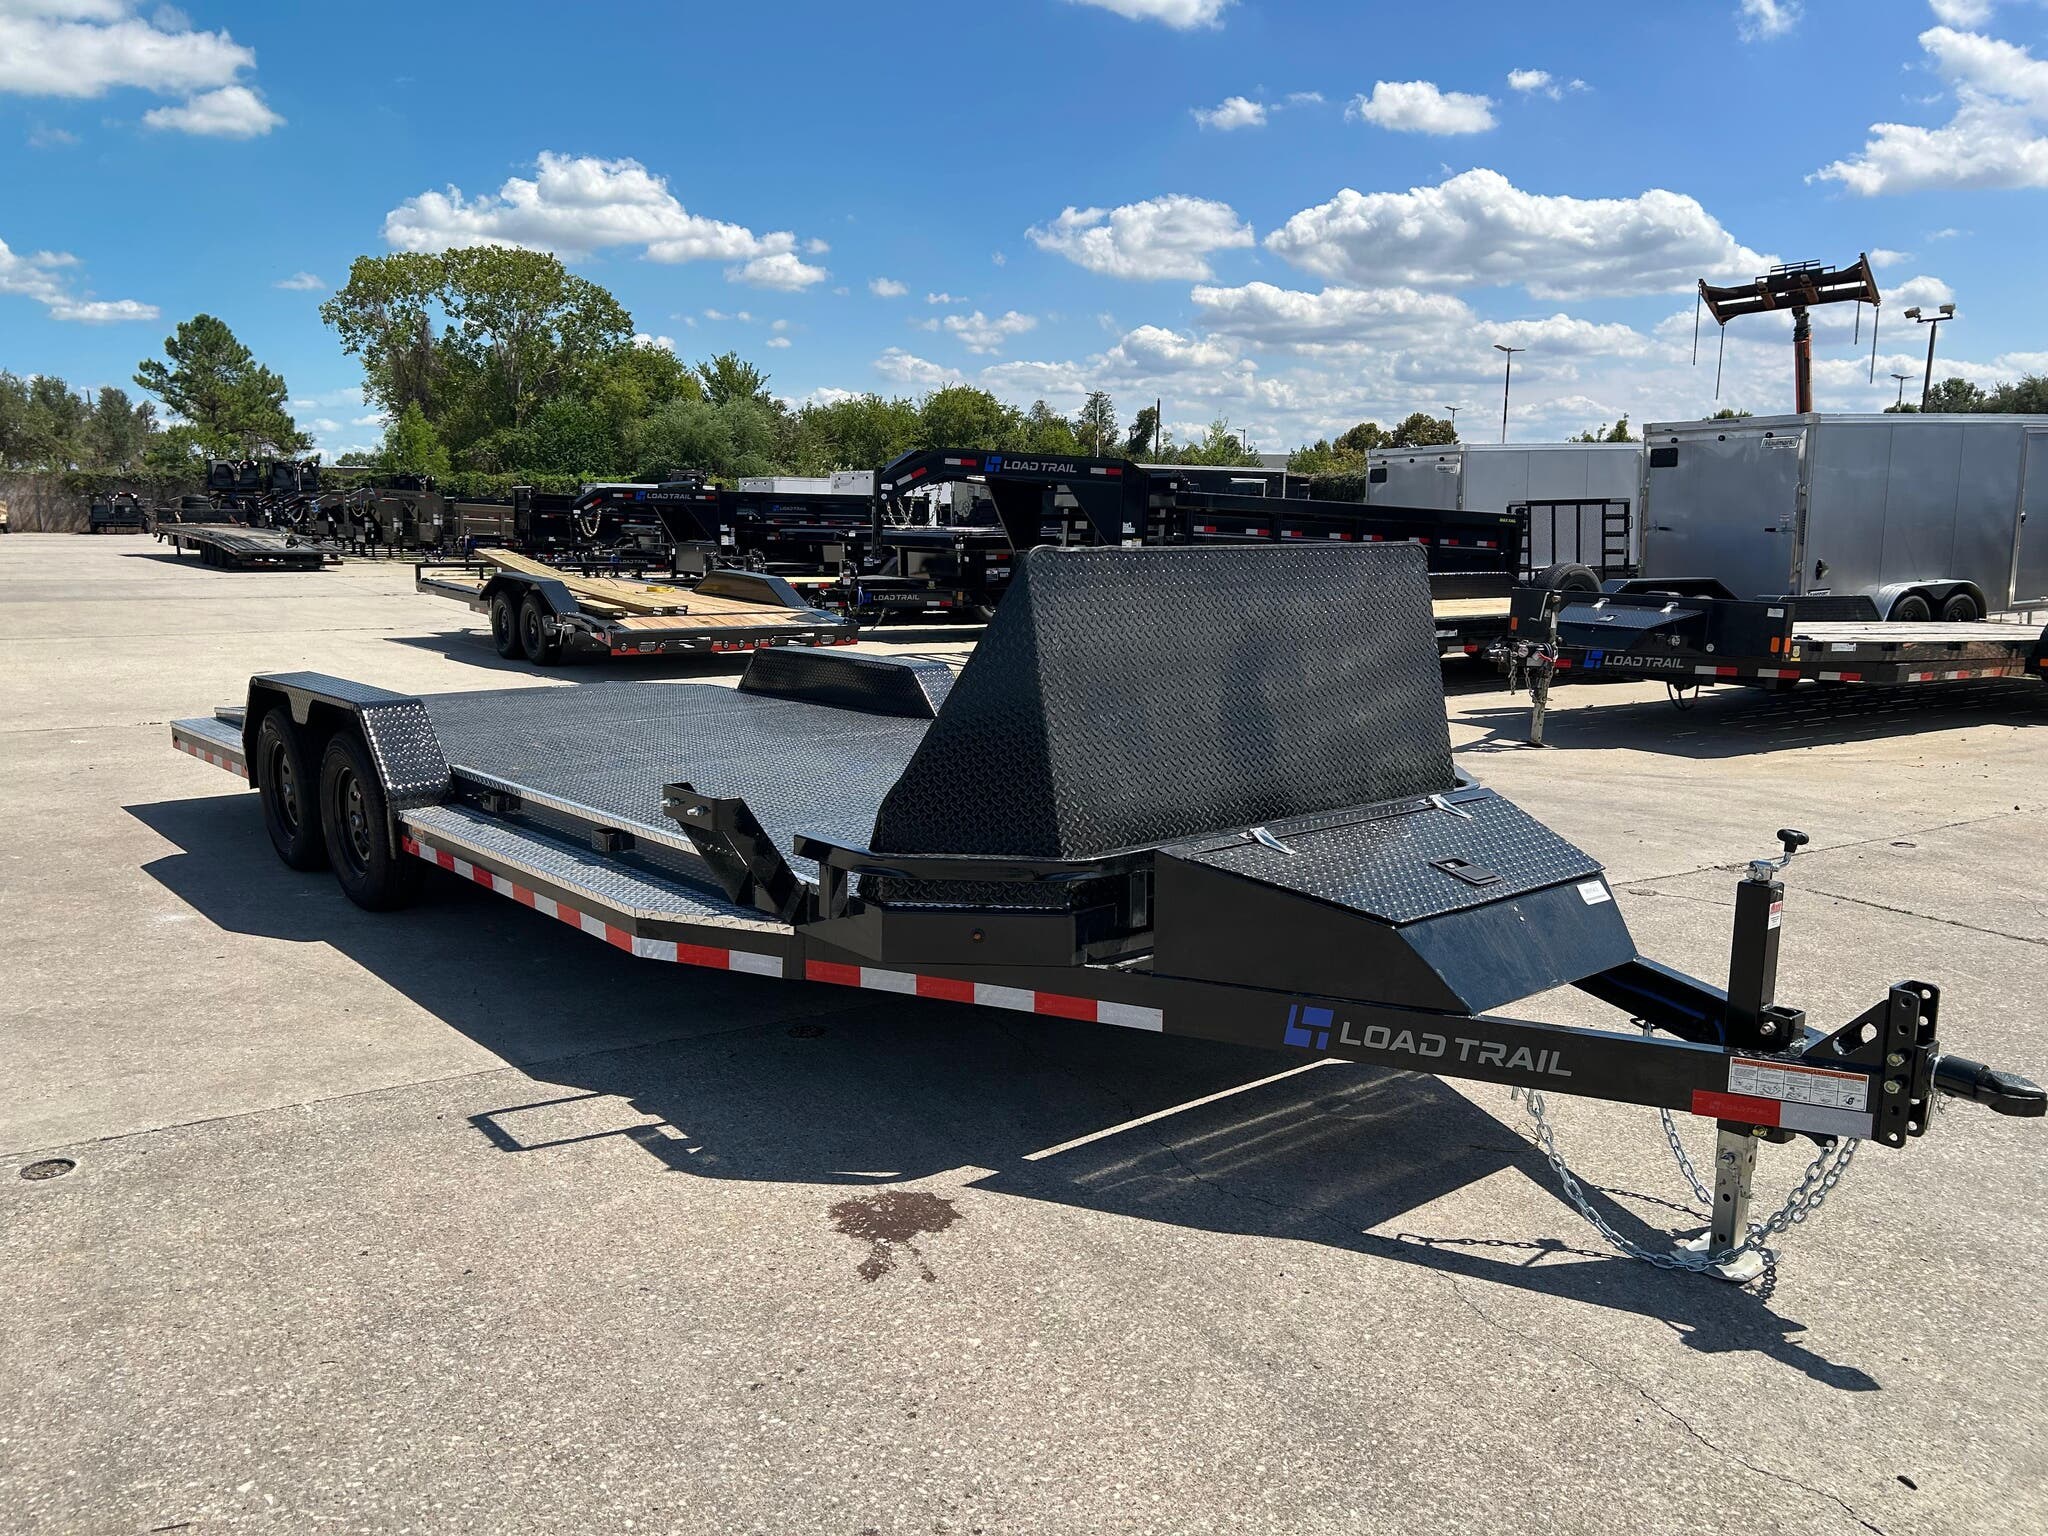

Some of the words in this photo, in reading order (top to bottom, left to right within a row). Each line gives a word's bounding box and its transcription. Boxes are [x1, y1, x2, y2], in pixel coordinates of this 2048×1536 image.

[1003, 459, 1039, 471] LOAD
[1041, 461, 1077, 473] TRAIL
[646, 492, 668, 500] LOAD
[669, 492, 692, 500] TRAIL
[896, 593, 921, 601] TRAIL
[1604, 655, 1644, 667] LOAD
[1645, 657, 1685, 669] TRAIL
[1339, 1021, 1447, 1057] LOAD
[1454, 1037, 1574, 1078] TRAIL
